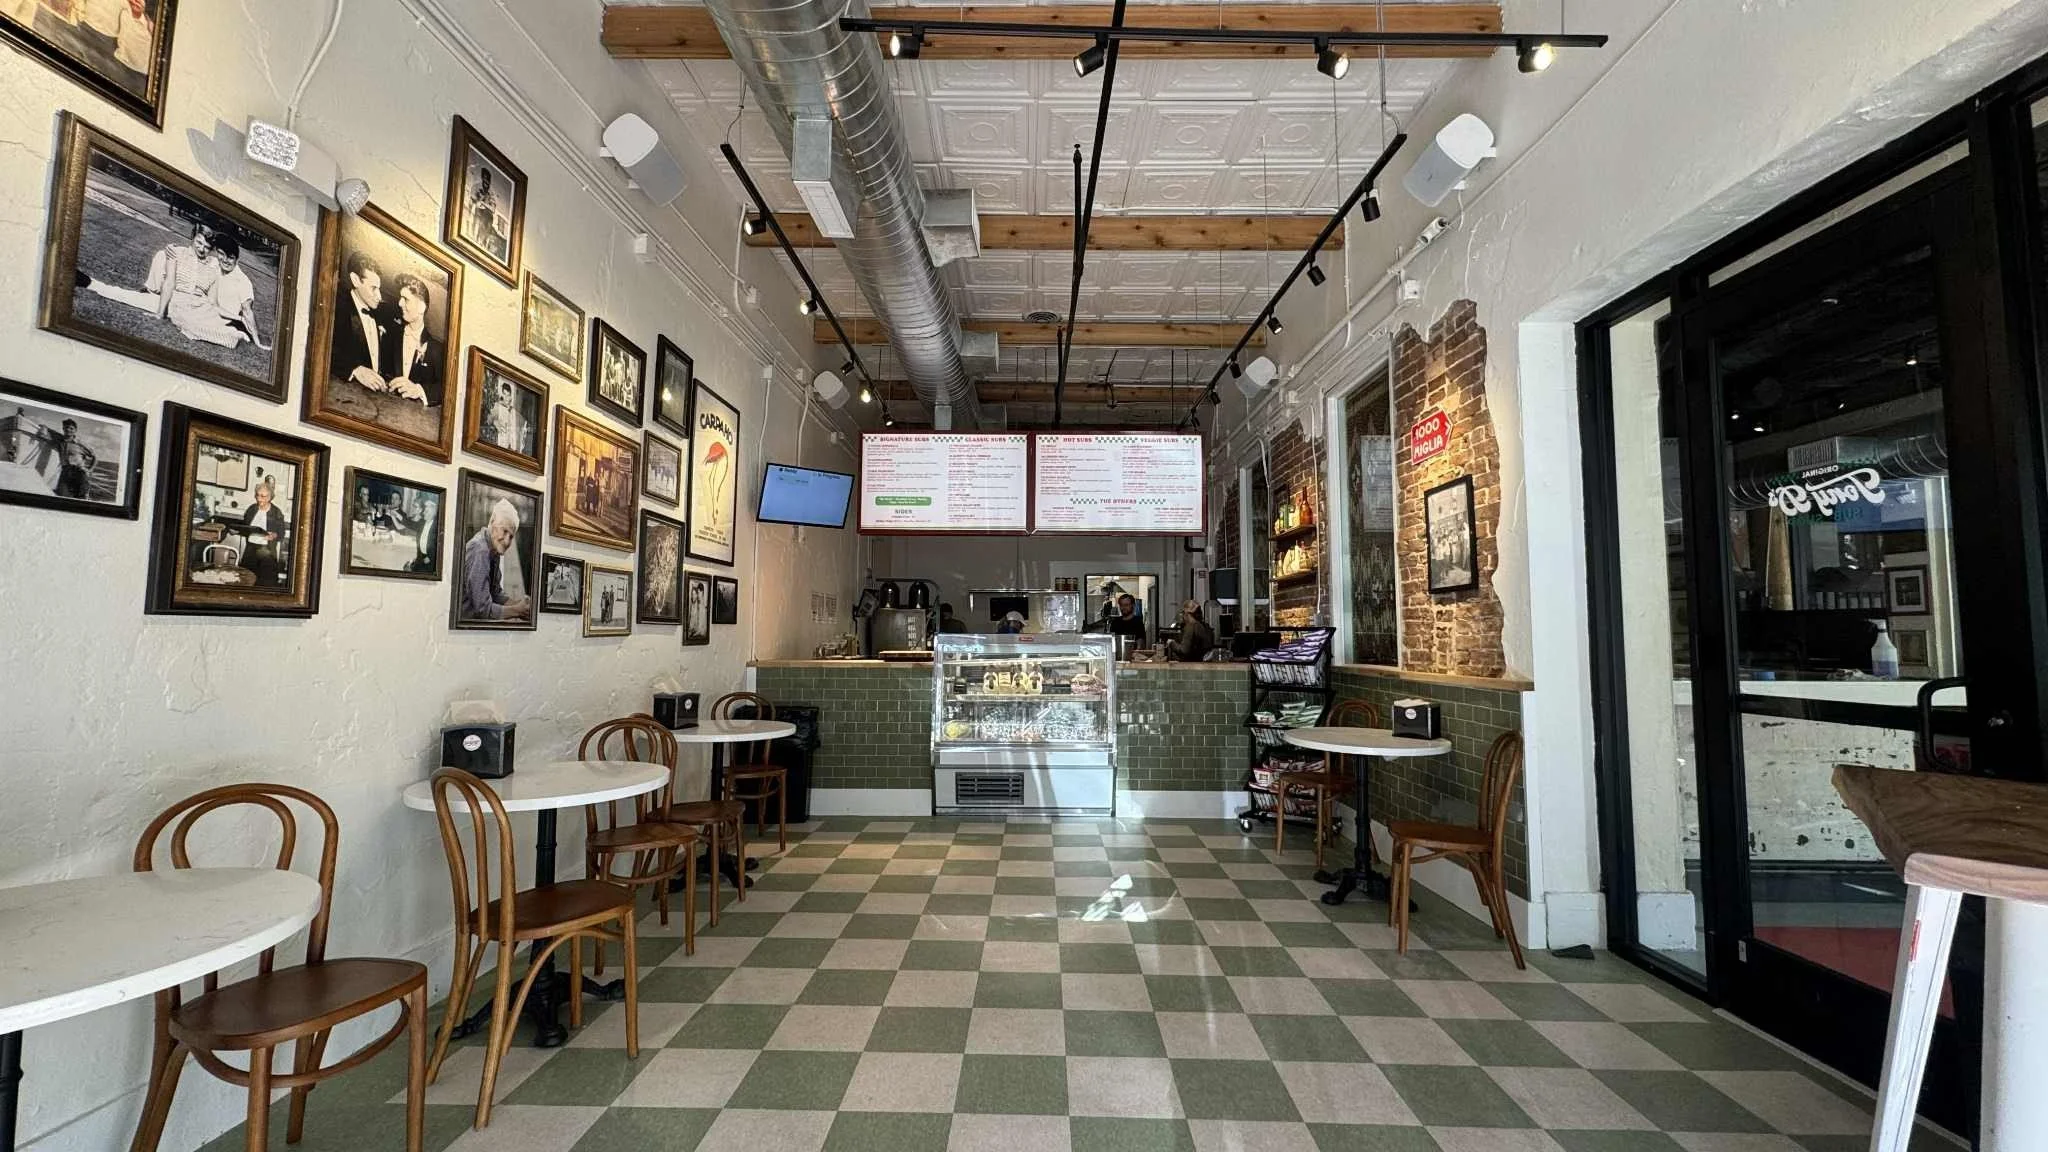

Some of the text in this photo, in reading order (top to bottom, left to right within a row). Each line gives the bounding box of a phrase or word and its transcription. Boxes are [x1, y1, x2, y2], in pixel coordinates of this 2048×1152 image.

[700, 413, 733, 445] CARPANO
[1415, 418, 1440, 440] 1000
[1414, 435, 1443, 459] MIGLIA
